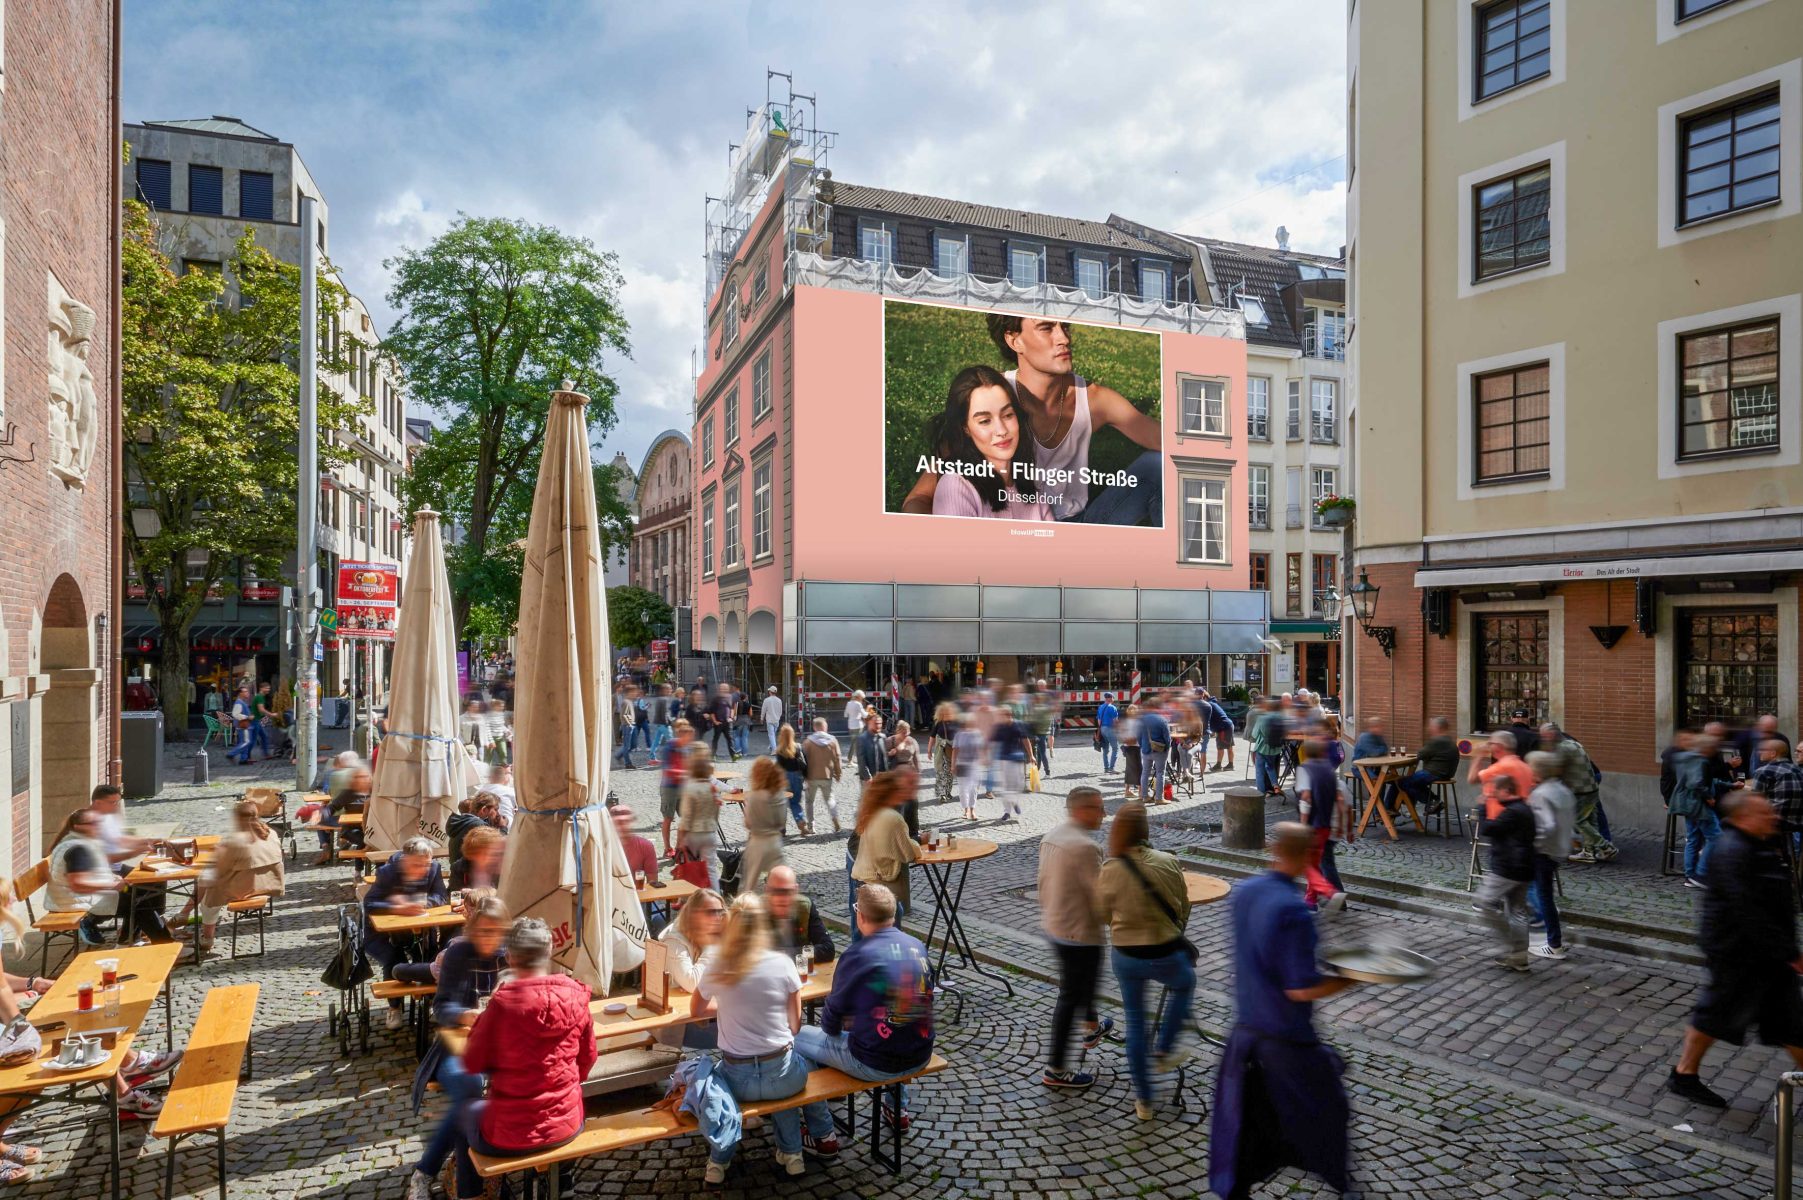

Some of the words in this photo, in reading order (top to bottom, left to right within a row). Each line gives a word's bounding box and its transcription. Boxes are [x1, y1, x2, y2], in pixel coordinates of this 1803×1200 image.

[916, 455, 995, 478] Altstadt
[1012, 462, 1075, 487] Flinger
[1079, 467, 1138, 488] Straße
[998, 489, 1064, 505] Düsseldorf
